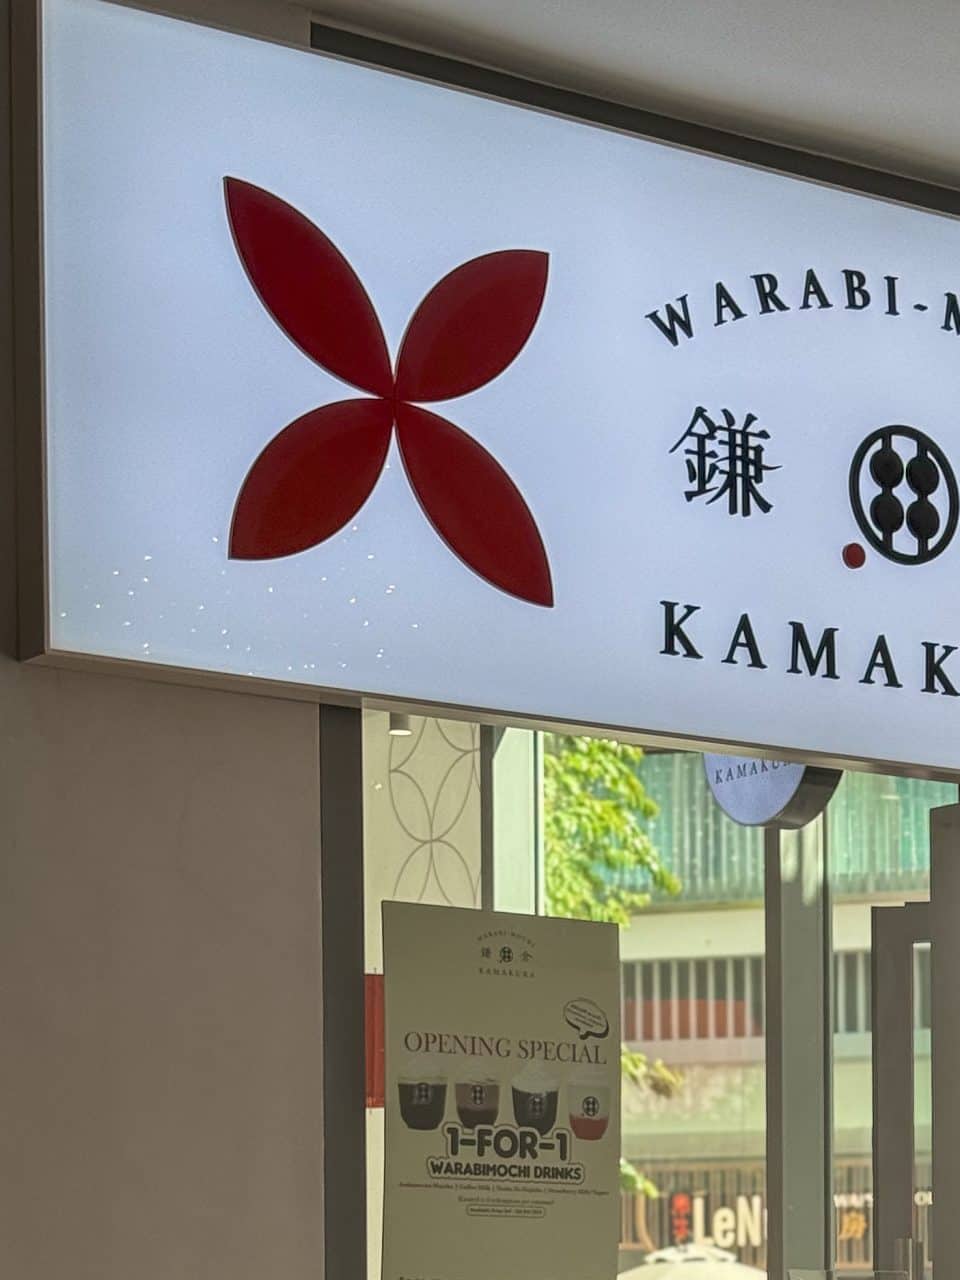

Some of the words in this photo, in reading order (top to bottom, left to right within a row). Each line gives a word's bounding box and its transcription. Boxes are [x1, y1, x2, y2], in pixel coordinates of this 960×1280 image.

[669, 406, 781, 518] 鎌
[404, 1031, 511, 1058] OPENING
[517, 1040, 607, 1065] SPECIAL
[446, 1126, 569, 1161] 1-FOR-1
[430, 1160, 530, 1180] WARABIMOCHI
[534, 1164, 582, 1181] DRINKS
[693, 1195, 768, 1248] LeN
